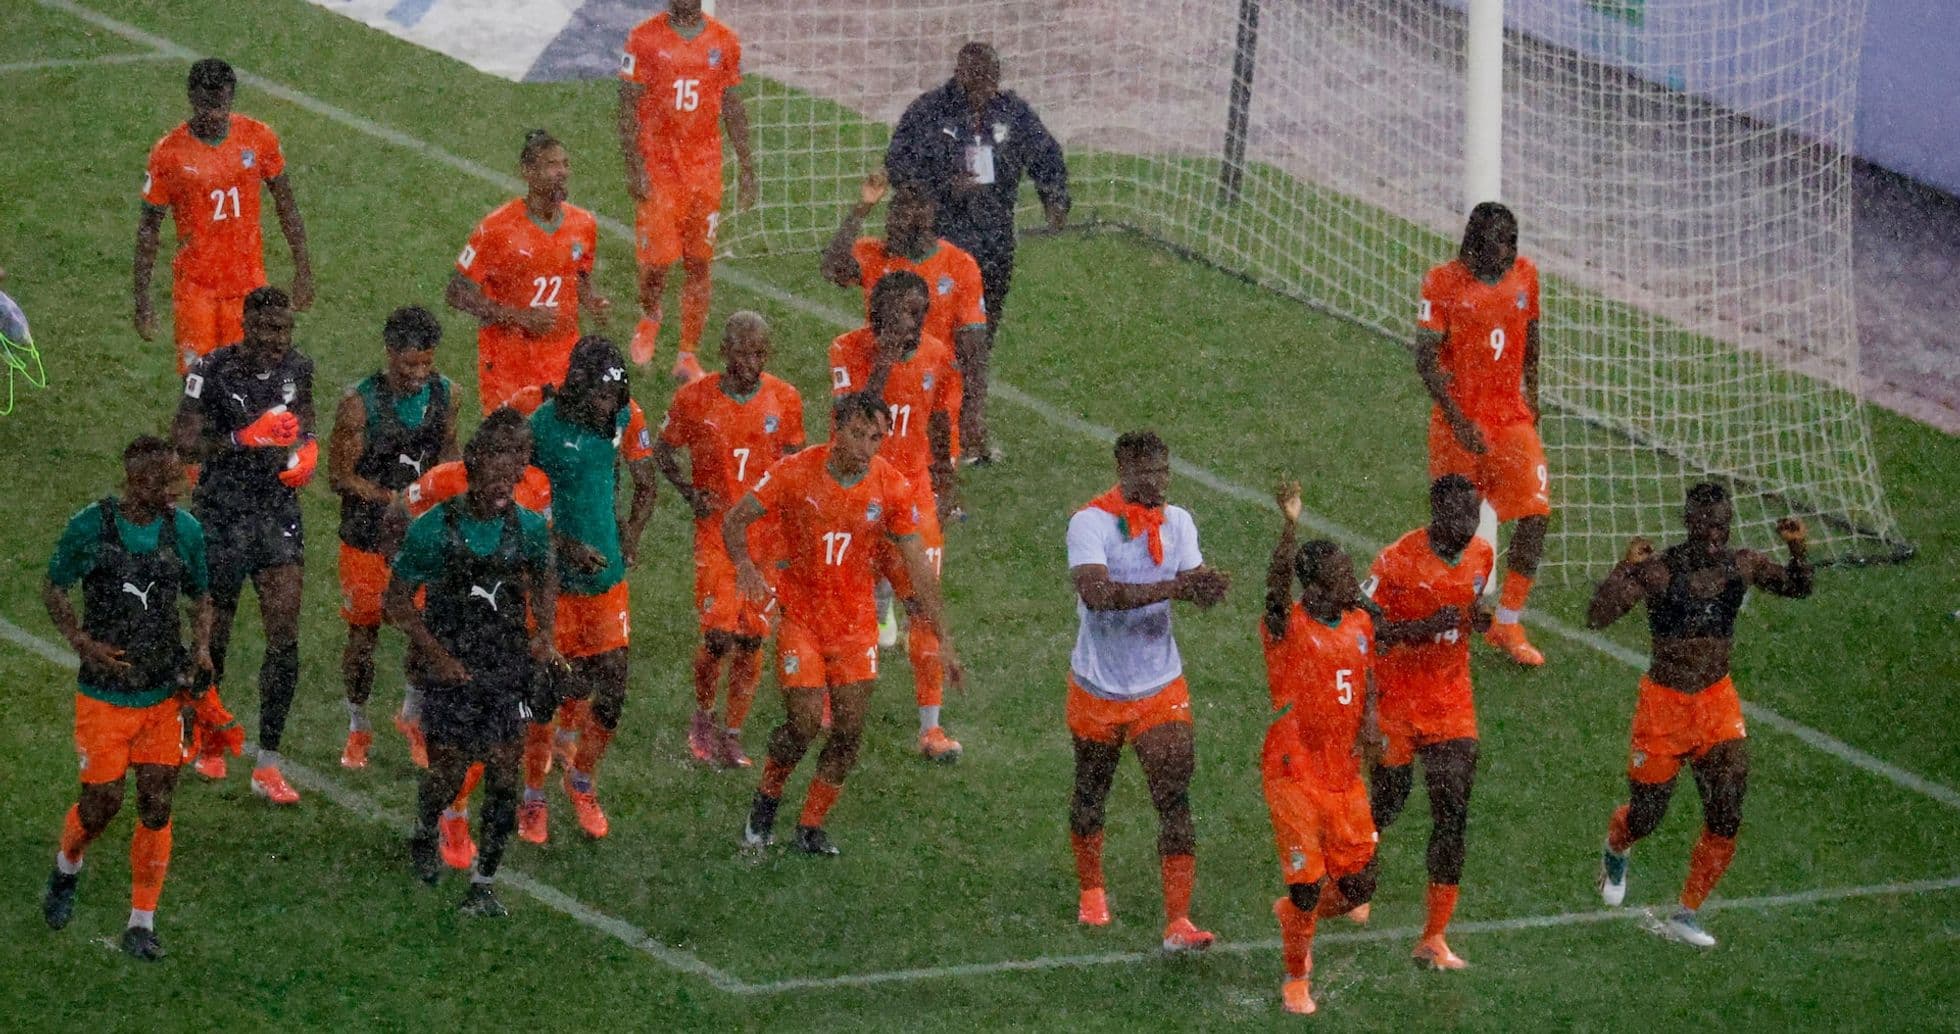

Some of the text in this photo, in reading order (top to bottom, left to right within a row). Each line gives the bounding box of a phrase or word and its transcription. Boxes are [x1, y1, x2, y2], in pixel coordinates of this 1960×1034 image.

[673, 80, 700, 112] 15
[210, 186, 240, 221] 21
[707, 212, 720, 239] 1
[529, 276, 562, 308] 22
[1490, 329, 1505, 361] 9
[888, 403, 911, 437] 11
[733, 448, 750, 482] 7
[1537, 464, 1547, 491] 9
[822, 531, 852, 566] 17
[1336, 669, 1353, 705] 5
